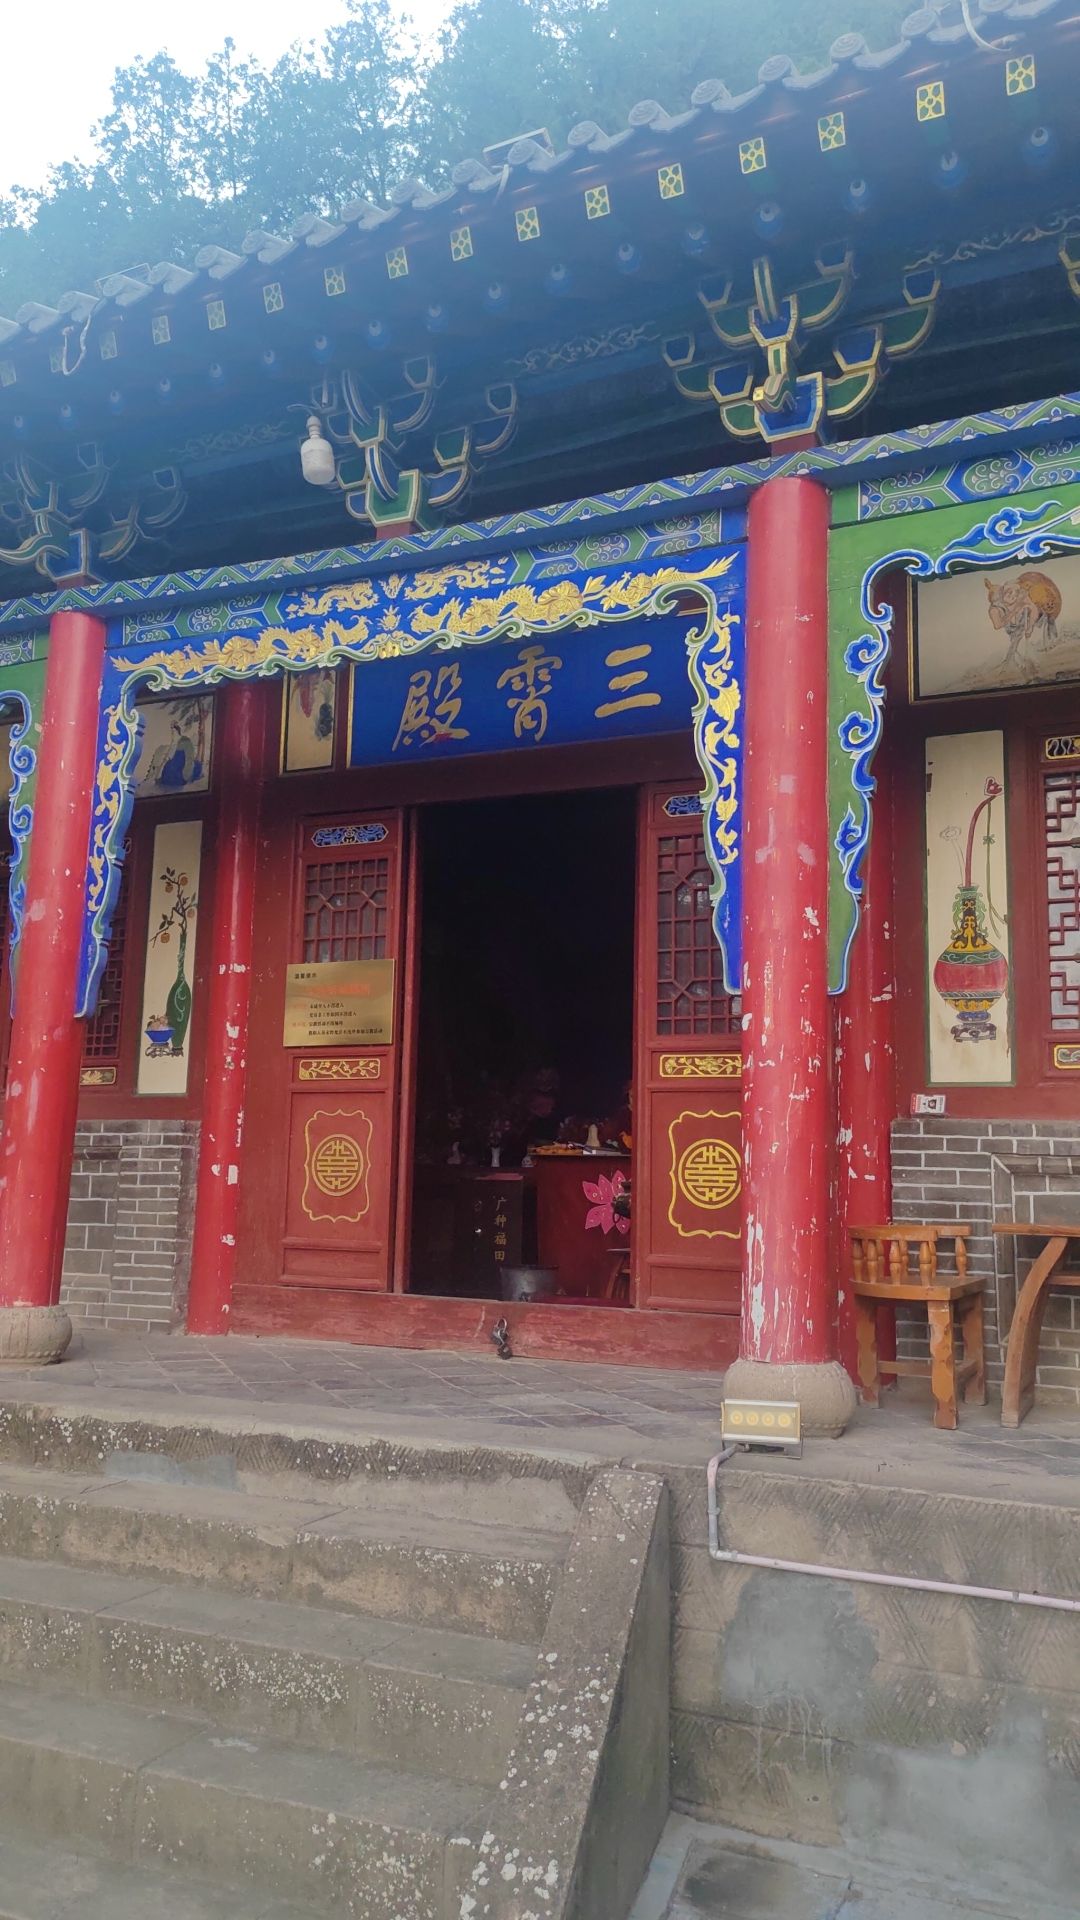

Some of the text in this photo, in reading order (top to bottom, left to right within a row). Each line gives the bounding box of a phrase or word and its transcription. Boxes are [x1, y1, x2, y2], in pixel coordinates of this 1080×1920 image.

[391, 644, 662, 752] 三霄殿
[495, 1197, 507, 1261] 广种福田
